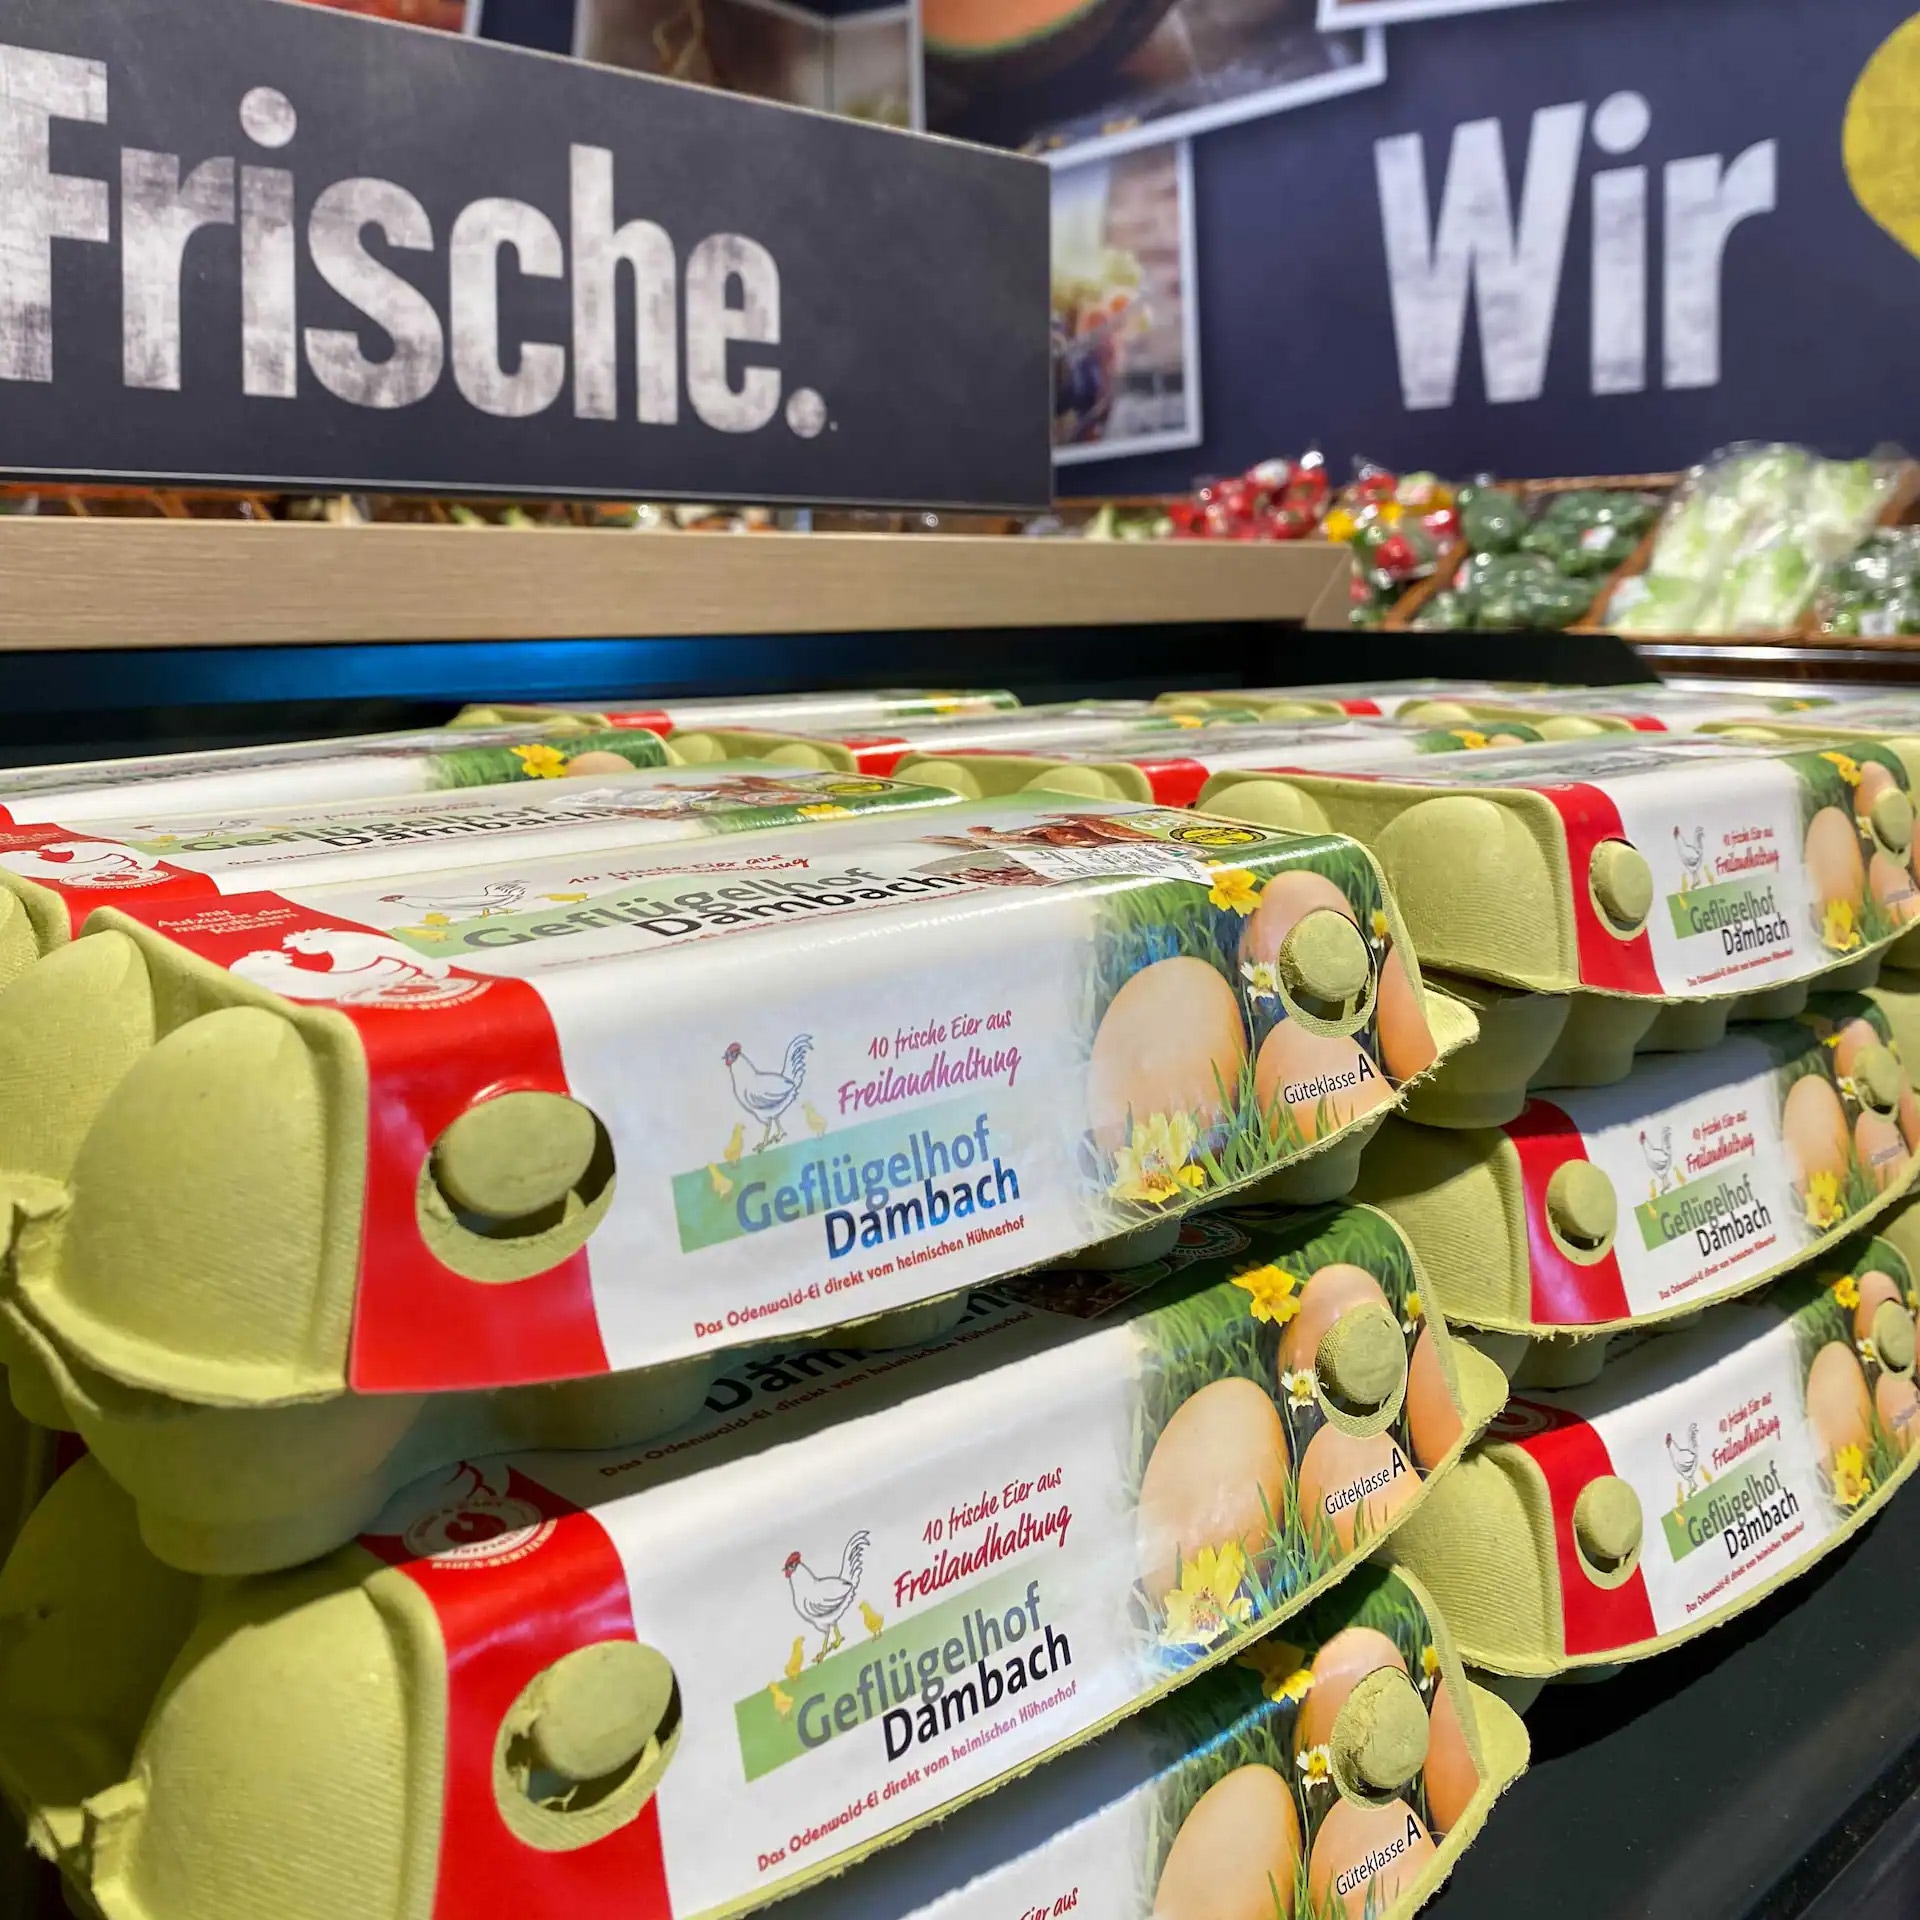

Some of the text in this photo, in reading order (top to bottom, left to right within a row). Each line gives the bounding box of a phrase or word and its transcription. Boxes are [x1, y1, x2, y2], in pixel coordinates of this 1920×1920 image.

[0, 43, 827, 438] Frische.
[1374, 91, 1777, 410] Wir
[180, 805, 551, 853] Geflügelhof
[463, 867, 887, 950] Geflügelhof
[632, 876, 967, 937] Dambach
[1690, 886, 1776, 933] Geflügelhof
[1722, 912, 1790, 956] Dambach
[868, 1009, 1012, 1060] 10 frische Eier aus
[837, 1045, 1022, 1115] Freilandhaltung
[1283, 1053, 1375, 1105] Güteklasse A
[736, 1112, 990, 1233] Geflügelhof
[824, 1157, 1021, 1259] Dambach
[1660, 1173, 1755, 1239] Geflügelhof
[1696, 1199, 1772, 1257] Dambach
[694, 1214, 1025, 1338] Das Odenwald-Ei direkt vom heimischen Hühnerhof
[600, 1458, 643, 1477] Das
[1325, 1447, 1407, 1515] Güteklasse A
[1687, 1460, 1783, 1548] Geflügelhof
[922, 1466, 1063, 1545] 10 frische Eier aus
[1723, 1488, 1800, 1559] Dambach
[894, 1504, 1073, 1608] Freilandhaltung
[796, 1580, 1041, 1750] Geflügelhof
[881, 1624, 1073, 1763] Dambach
[757, 1680, 1078, 1872] Das Odenwald-Ei direkt vom heimischen Hühnerhof
[1336, 1813, 1422, 1895] Güteklasse A
[1053, 1887, 1078, 1917] aus
